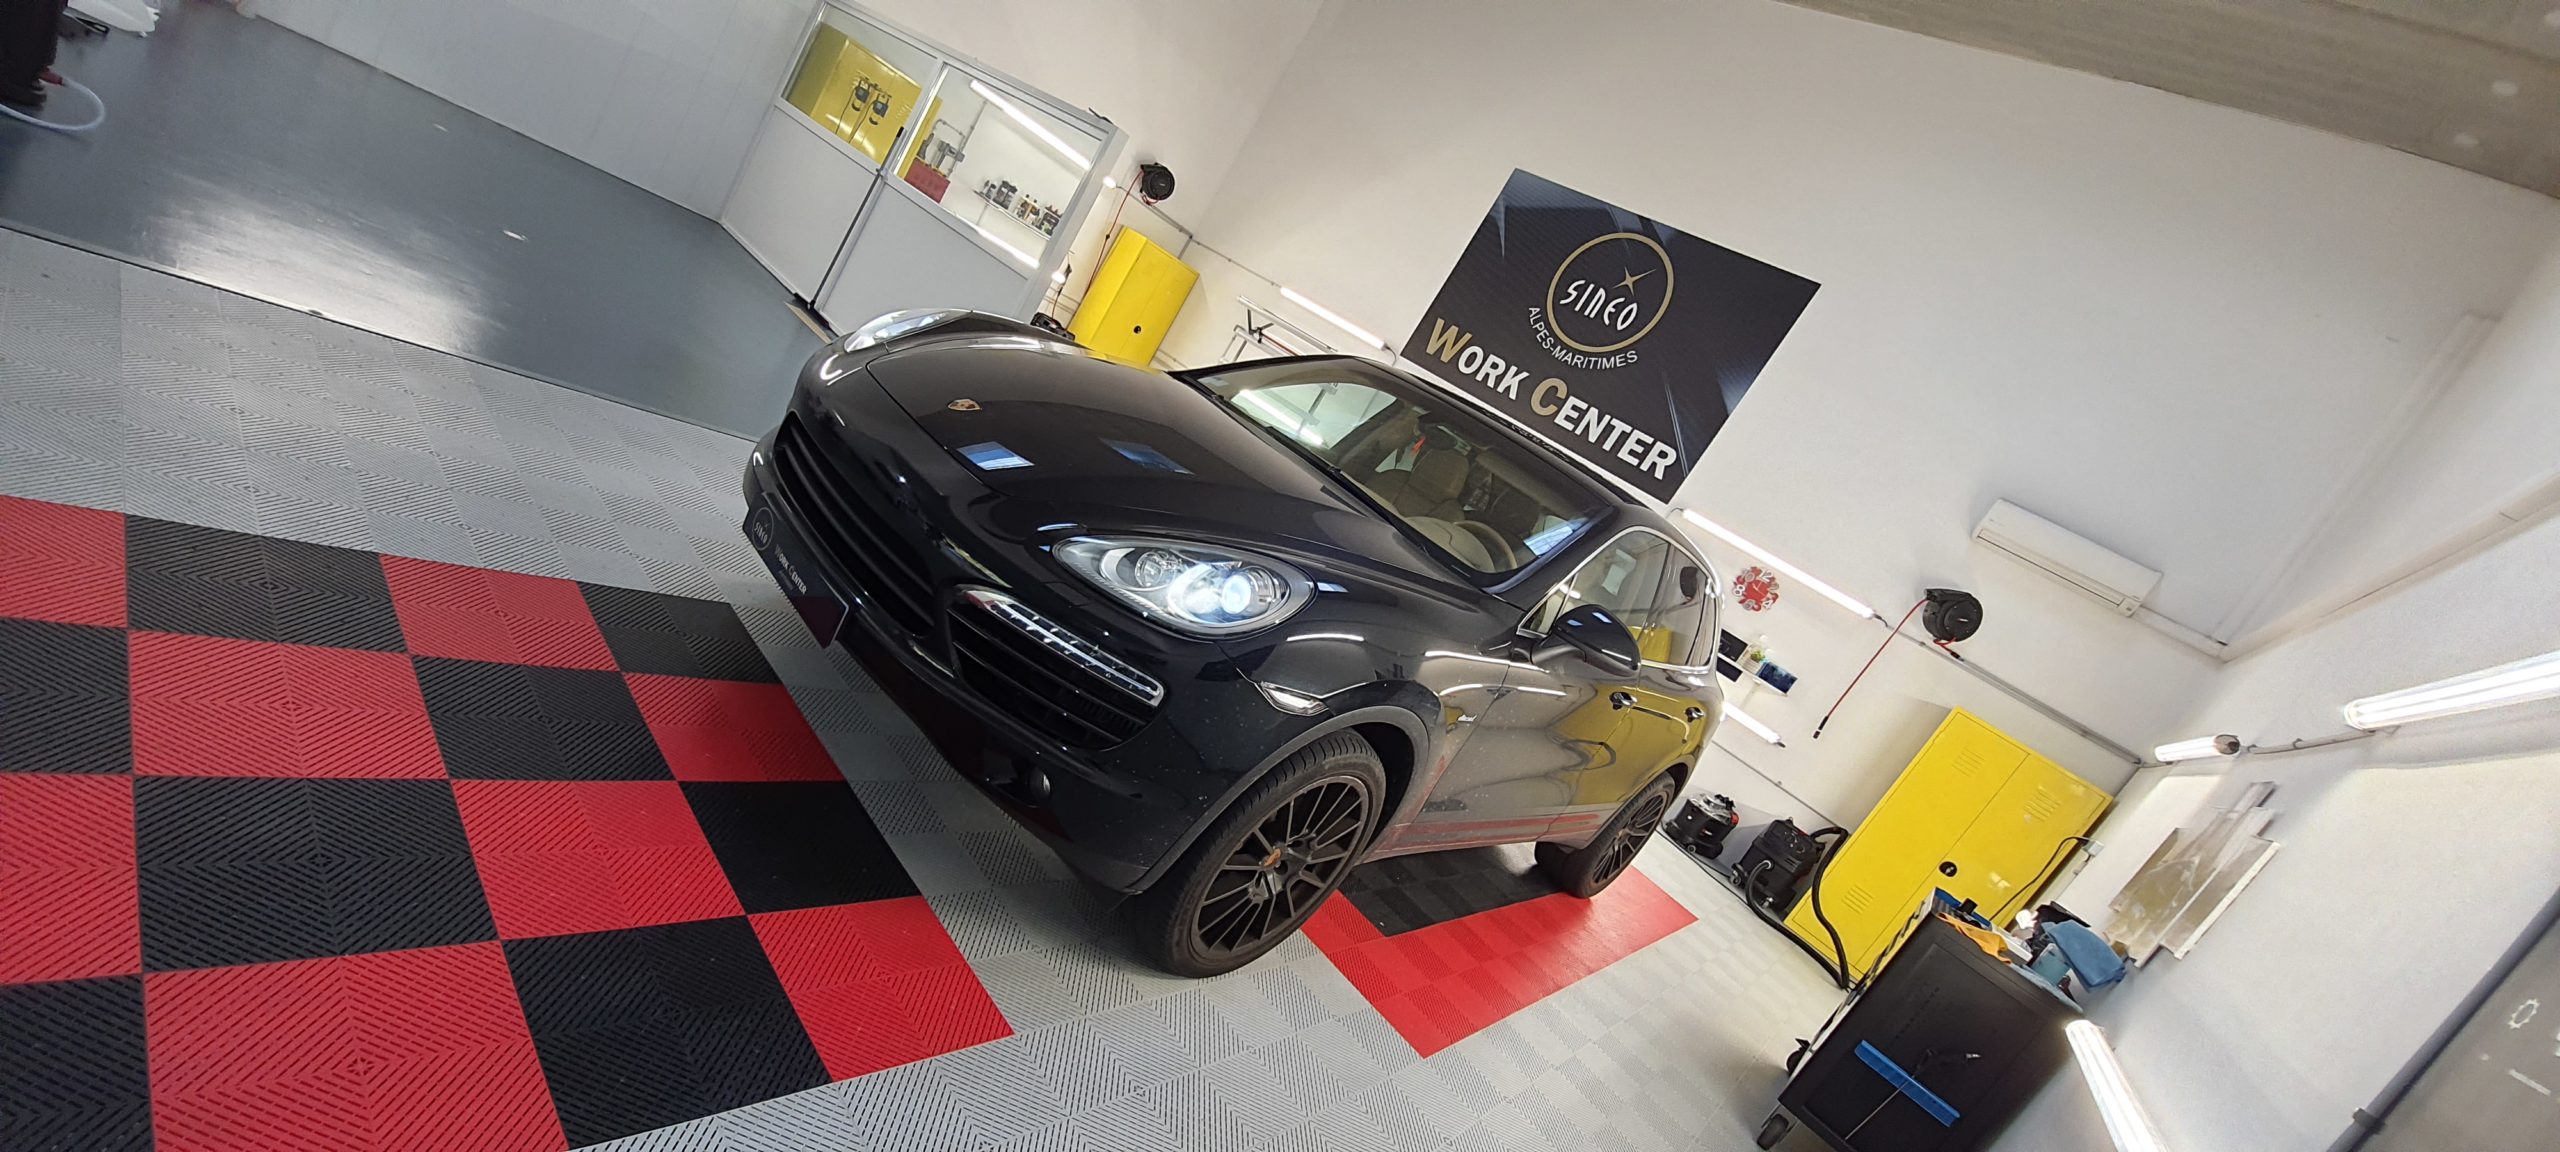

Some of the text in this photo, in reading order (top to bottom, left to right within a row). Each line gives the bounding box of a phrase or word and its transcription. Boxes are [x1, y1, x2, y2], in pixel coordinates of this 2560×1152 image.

[1559, 279, 1640, 332] SINEO
[1528, 306, 1639, 370] ALPES-MARITIMES
[1426, 317, 1678, 480] WORK CENTER
[788, 565, 807, 595] CENTER
[1732, 584, 1745, 597] 8
[1759, 567, 1774, 582] 12
